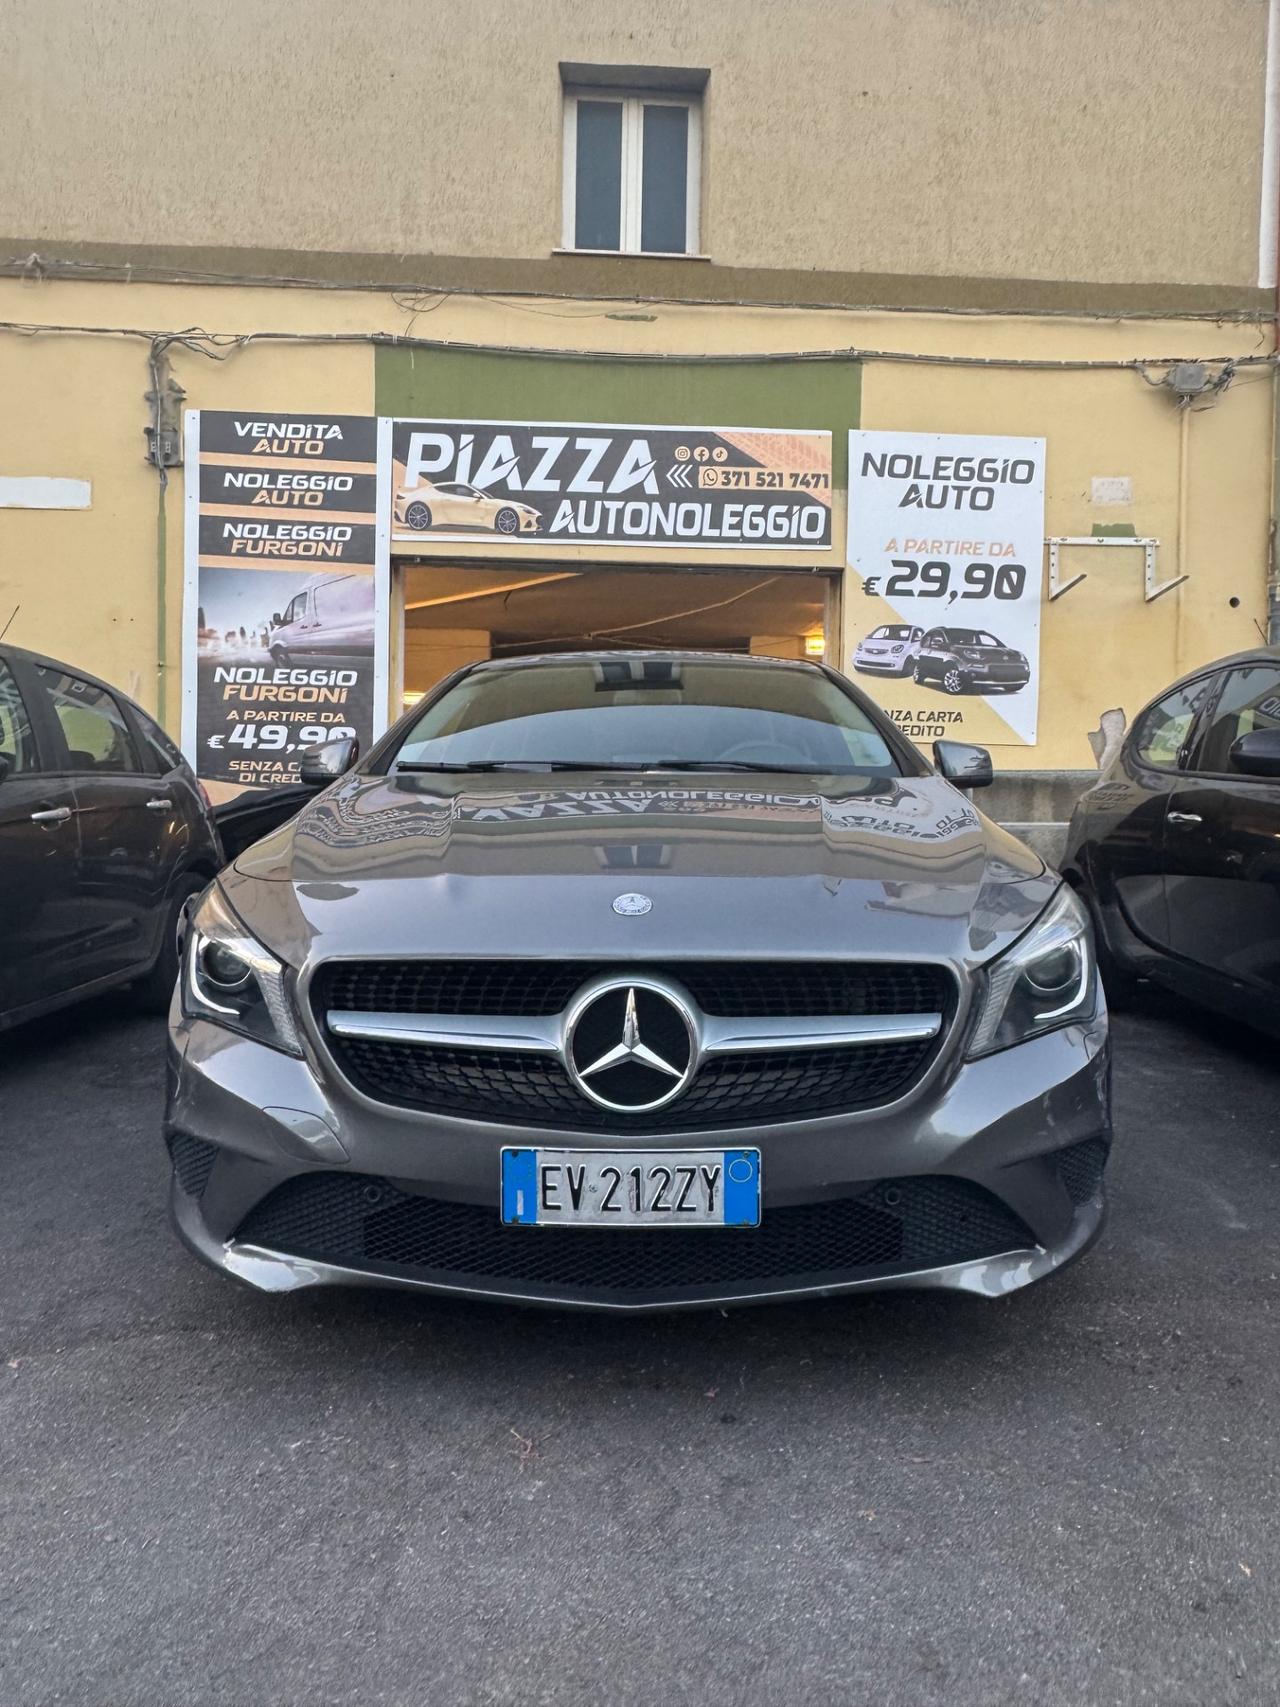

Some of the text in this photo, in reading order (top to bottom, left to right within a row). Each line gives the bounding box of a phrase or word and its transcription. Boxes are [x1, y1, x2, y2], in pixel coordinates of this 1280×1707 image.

[234, 421, 343, 440] VENDITA
[251, 438, 325, 455] AUTO
[404, 431, 660, 495] PIAZZA
[861, 452, 1035, 485] NOLEGGIO
[224, 472, 353, 491] NOLEGGIO
[721, 470, 829, 489] 371 521 7471
[251, 490, 325, 506] AUTO
[898, 483, 995, 511] AUTO
[549, 499, 827, 540] AUTONOLEGGIO
[222, 522, 353, 541] NOLEGGIO
[230, 539, 344, 557] FURGONI
[884, 538, 1018, 558] A PARTIRE DA
[214, 667, 358, 686] NOLEGGIO
[223, 684, 348, 704] FURGONI
[226, 709, 346, 723] A PARTIRE DA
[883, 709, 964, 723] NZA CARTA
[896, 724, 945, 737] EDITO
[228, 760, 284, 772] SENZA
[239, 772, 302, 784] DI CRED
